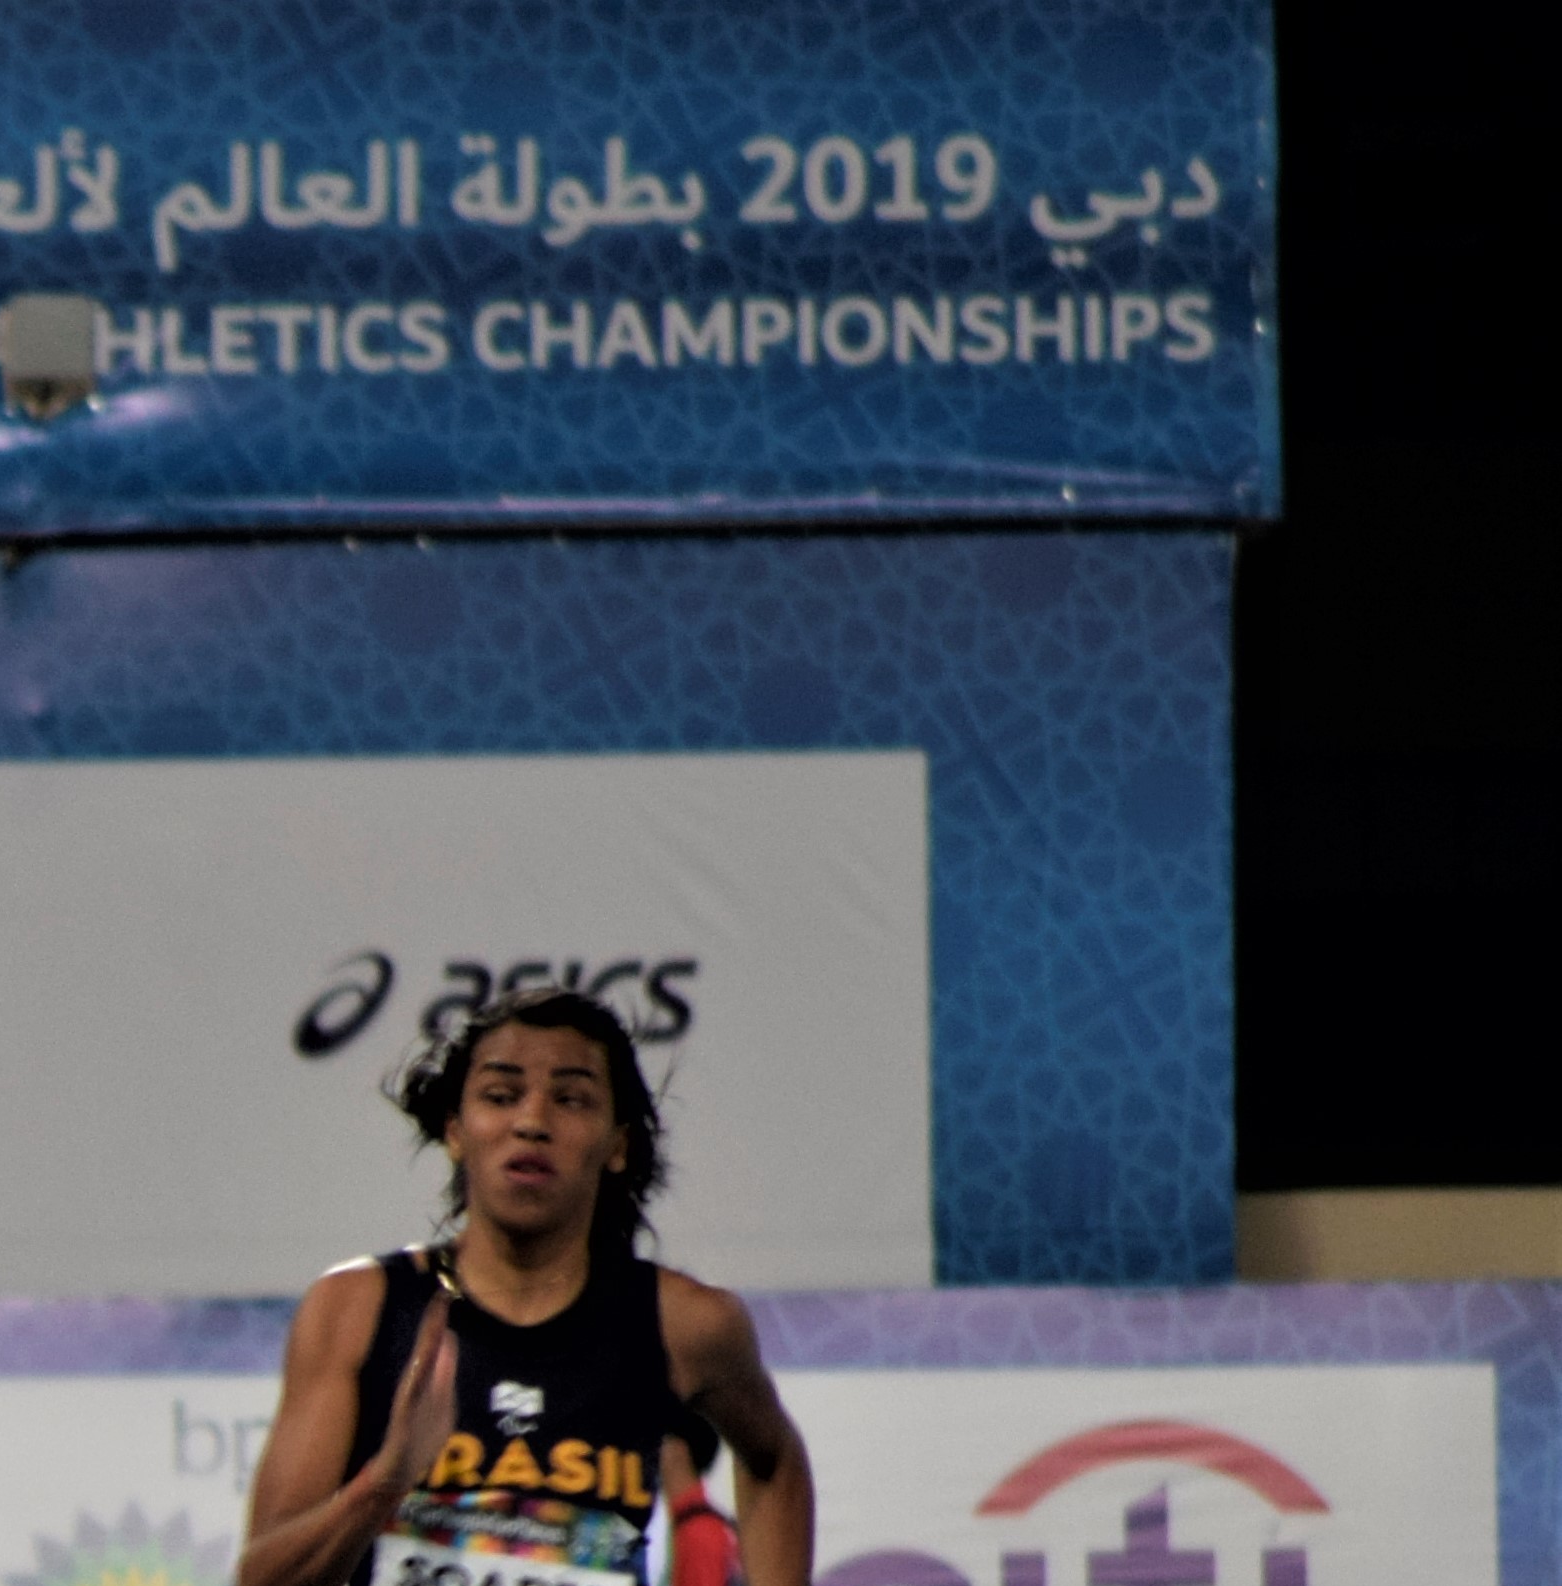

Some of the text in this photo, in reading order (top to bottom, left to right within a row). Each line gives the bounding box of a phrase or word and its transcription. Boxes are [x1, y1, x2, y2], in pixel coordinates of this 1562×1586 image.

[151, 141, 420, 271] العالم
[450, 131, 706, 252] بطولة
[737, 136, 997, 222] 2019
[1031, 156, 1221, 268] دبي
[479, 294, 1217, 371] CHAMPIONSHIPS
[428, 1431, 653, 1508] RASIL
